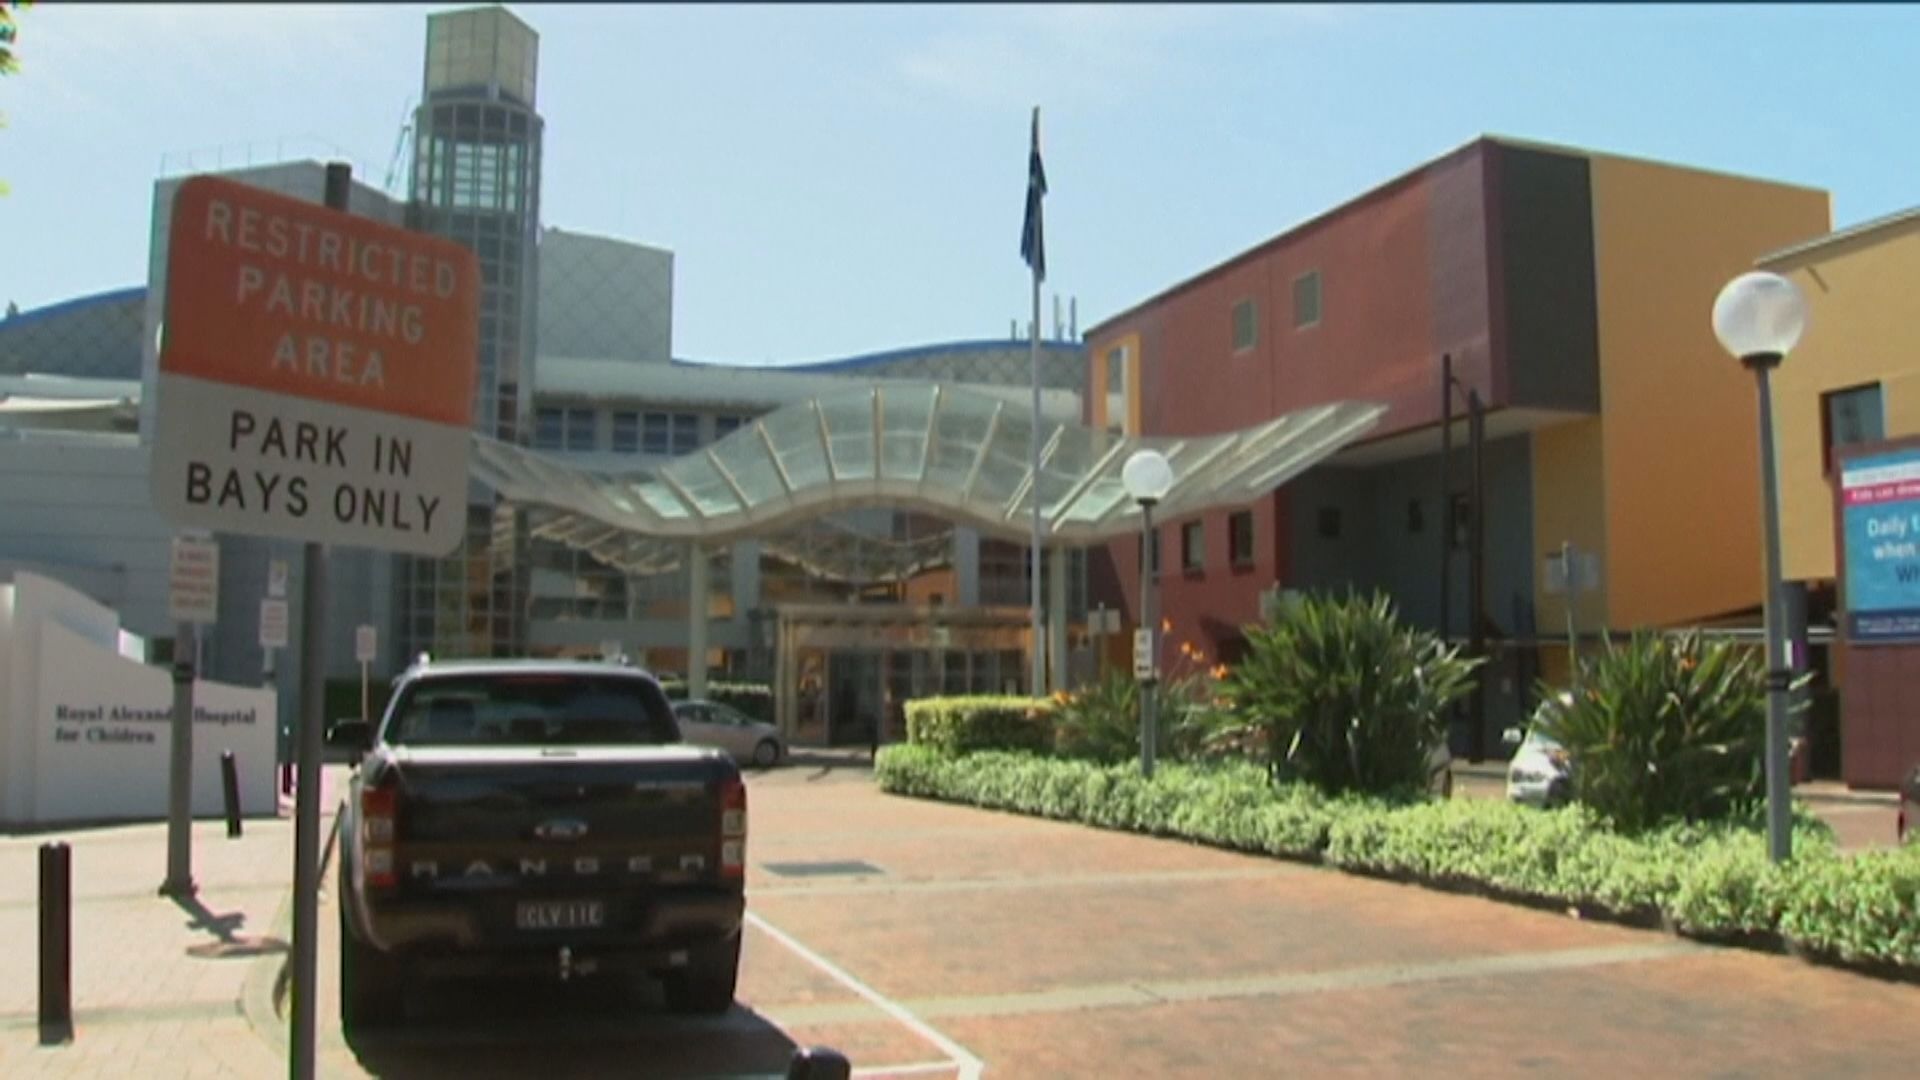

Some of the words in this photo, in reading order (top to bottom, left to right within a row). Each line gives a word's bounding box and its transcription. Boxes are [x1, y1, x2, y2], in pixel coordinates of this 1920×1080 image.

[205, 200, 458, 298] RESTRICTED
[237, 265, 425, 343] PARKING
[271, 334, 385, 387] AREA
[230, 410, 347, 468] PARK
[373, 435, 413, 477] IN
[186, 461, 309, 518] BAYS
[334, 484, 440, 533] ONLY
[56, 704, 103, 724] Royal
[109, 704, 175, 722] Alexand
[194, 706, 256, 726] Hospital
[56, 726, 79, 743] for
[410, 854, 705, 877] RANGER
